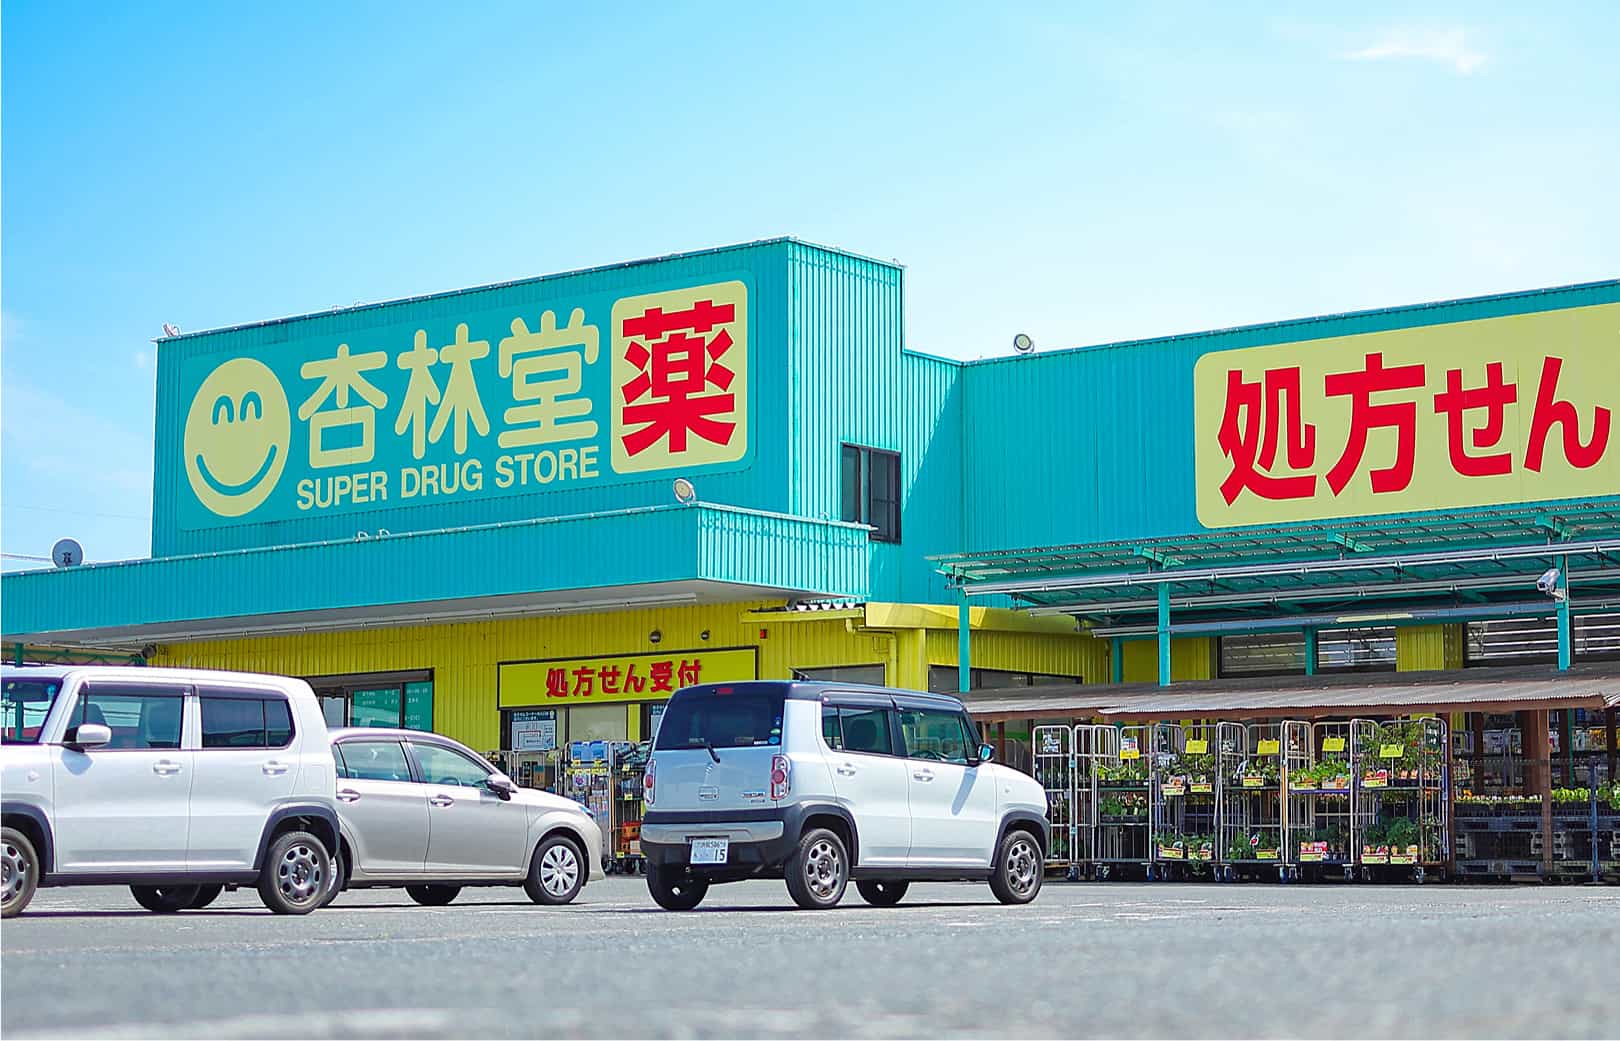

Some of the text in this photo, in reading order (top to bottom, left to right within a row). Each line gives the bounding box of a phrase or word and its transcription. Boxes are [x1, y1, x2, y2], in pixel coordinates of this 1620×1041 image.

[298, 308, 600, 469] 杏林堂
[621, 299, 736, 457] 薬
[1217, 352, 1612, 506] 処方せん
[296, 445, 600, 511] SUPER DRUG STORE
[545, 658, 703, 698] 処方せん受付
